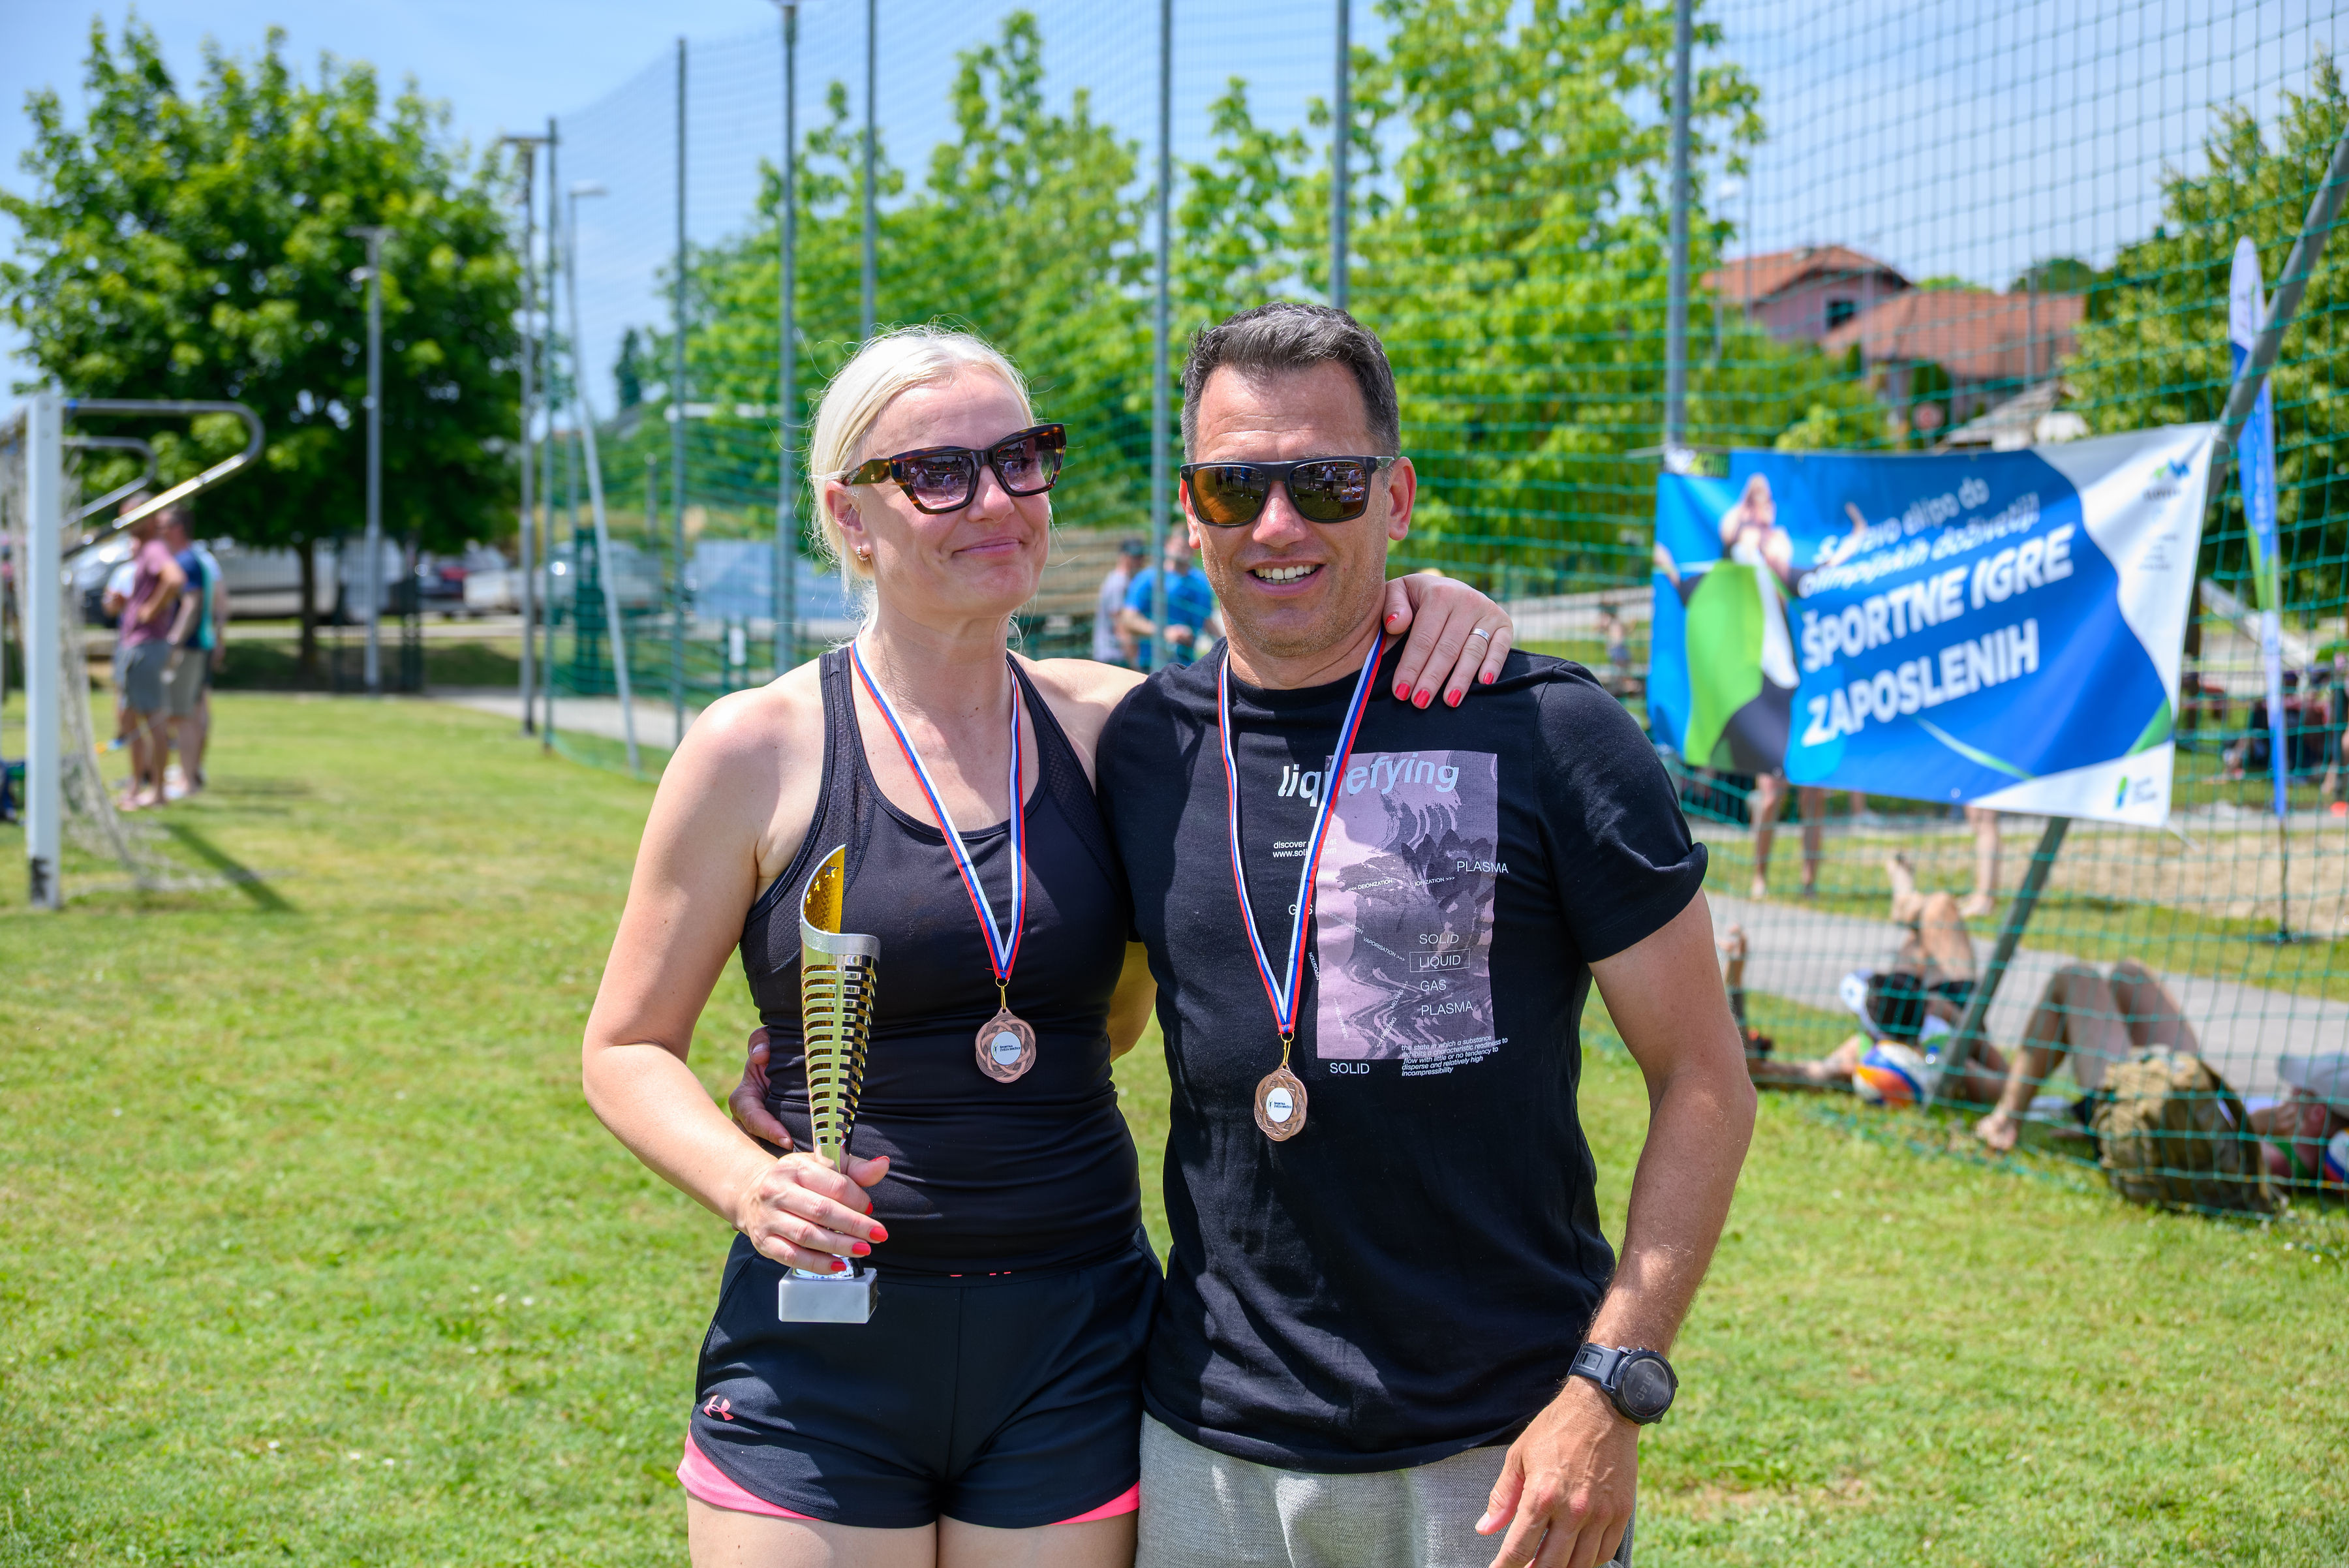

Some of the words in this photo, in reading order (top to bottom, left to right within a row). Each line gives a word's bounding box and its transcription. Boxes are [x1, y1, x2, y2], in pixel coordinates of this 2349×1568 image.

[1958, 477, 1990, 510] do
[1801, 565, 1970, 673] ŠPORTNE
[1971, 523, 2075, 610] IGRE
[1801, 618, 2040, 748] ZAPOSLENIH
[1278, 753, 1460, 807] liqefying
[1457, 861, 1509, 874] PLASMA
[1358, 879, 1392, 890] DEIONIZATION
[1415, 877, 1445, 886] IONIZATION
[1289, 904, 1313, 915] GS
[1328, 913, 1364, 934] CONDENSATION
[1419, 934, 1459, 944] SOLID
[1363, 936, 1396, 957] VAPORISATION
[1308, 952, 1320, 980] DEPOSITION
[1419, 955, 1461, 968] LIQUID
[1420, 979, 1447, 992] GAS
[1390, 989, 1404, 1009] MELTING
[1421, 1001, 1473, 1016] PLASMA
[1381, 1017, 1397, 1039] FREEZING
[1434, 1044, 1473, 1055] characteristic
[1474, 1039, 1501, 1049] readiness
[1462, 1036, 1492, 1045] substance
[1465, 1049, 1491, 1058] tendency
[1443, 1057, 1469, 1066] relatively
[1330, 1063, 1370, 1074] SOLID
[1402, 1066, 1454, 1077] incompressibility
